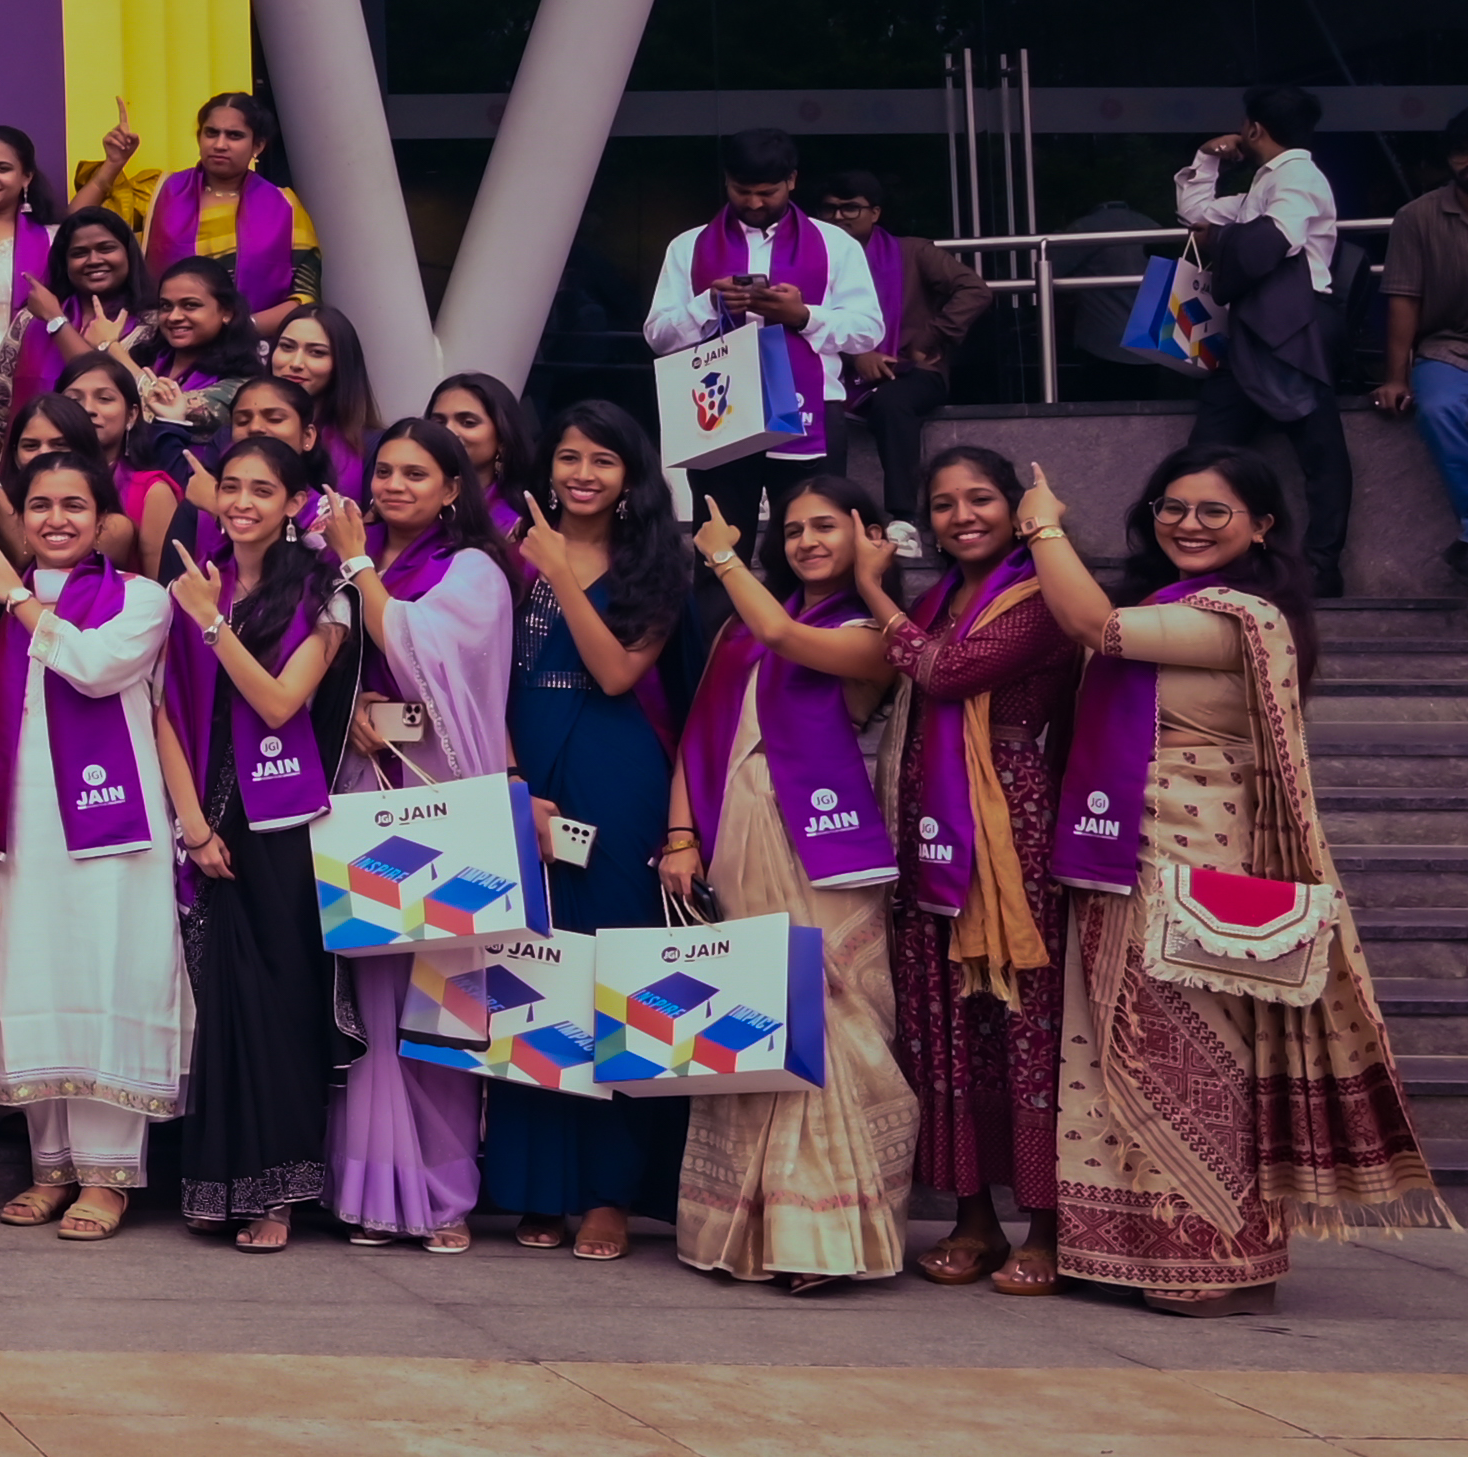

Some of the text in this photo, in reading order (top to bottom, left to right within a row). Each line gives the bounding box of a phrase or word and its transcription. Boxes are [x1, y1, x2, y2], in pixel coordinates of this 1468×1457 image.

[704, 344, 729, 364] JAIN
[251, 757, 301, 779] JAIN
[76, 785, 126, 807] JAIN
[398, 802, 448, 823] JAIN
[804, 810, 860, 833] JAIN
[1074, 816, 1120, 838] JAIN
[354, 856, 411, 884] INSPIRE
[460, 866, 517, 891] IMPACT
[508, 942, 562, 964] JAIN
[685, 939, 730, 958] JAIN
[630, 988, 687, 1018] INSPIRE
[729, 1004, 779, 1032] IMPACT
[556, 1020, 595, 1055] IMPAC
